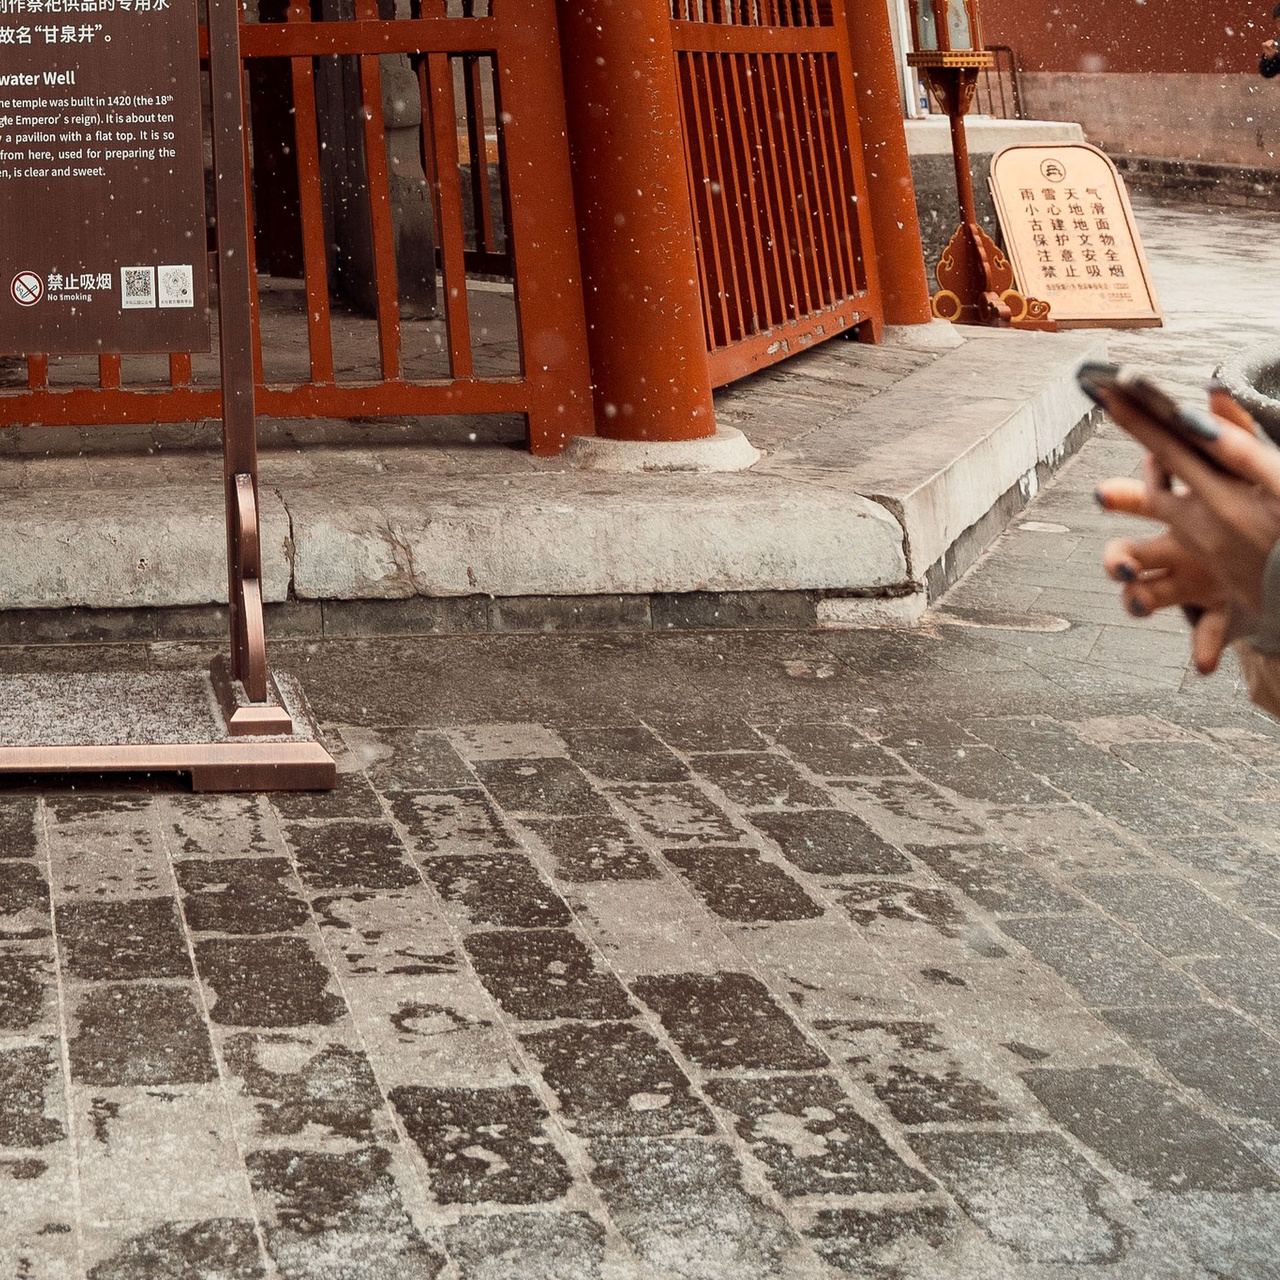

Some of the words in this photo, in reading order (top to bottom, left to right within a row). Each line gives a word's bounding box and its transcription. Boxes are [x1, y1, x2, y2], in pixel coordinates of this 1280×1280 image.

[43, 71, 75, 85] Well
[13, 98, 47, 109] temple
[71, 97, 94, 106] built
[96, 97, 105, 106] in
[108, 96, 131, 105] 1420
[133, 96, 153, 107] (the
[156, 95, 173, 105] 18th
[72, 113, 103, 126] reign).
[106, 114, 113, 123] It
[116, 113, 123, 123] is
[126, 113, 155, 123] about
[158, 114, 173, 122] ten
[16, 132, 55, 144] pavilion
[60, 132, 82, 141] with
[96, 131, 112, 141] flat
[116, 132, 136, 142] top.
[140, 131, 147, 140] It
[151, 131, 159, 140] is
[0, 150, 24, 160] from
[28, 150, 54, 160] here,
[59, 149, 82, 158] used
[87, 149, 101, 158] for
[106, 148, 155, 159] preparing
[159, 148, 175, 157] the
[14, 167, 22, 177] is
[24, 167, 49, 177] clear
[52, 167, 71, 176] and
[73, 167, 106, 176] sweet.
[1019, 188, 1102, 200] 雨雪天气
[1026, 203, 1105, 215] 小心地滑
[1028, 218, 1110, 231] 古建地面
[1033, 233, 1115, 246] 保护文物
[1038, 249, 1120, 262] 注意安全
[1042, 265, 1124, 278] 禁止吸烟
[48, 273, 112, 291] 禁止吸烟
